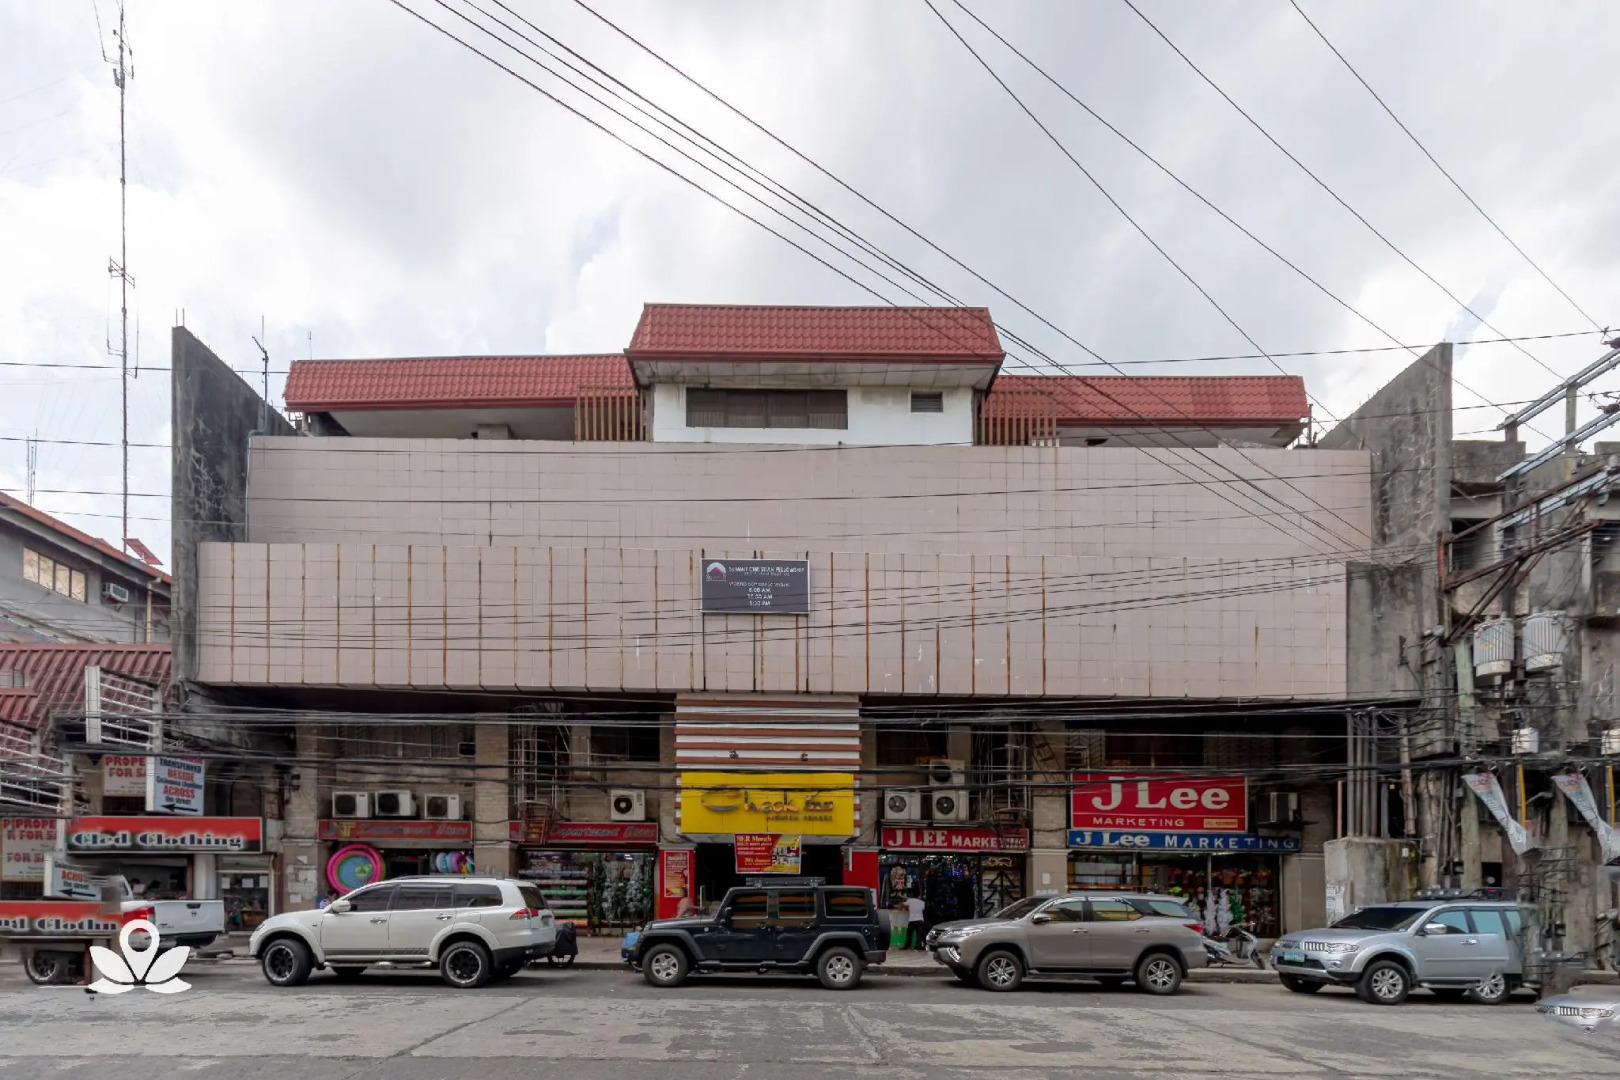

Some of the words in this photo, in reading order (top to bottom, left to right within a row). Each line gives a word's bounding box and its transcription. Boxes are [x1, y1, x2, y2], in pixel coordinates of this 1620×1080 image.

[109, 768, 132, 777] FOR
[163, 785, 195, 799] ACROSS
[1092, 776, 1122, 810] J
[1135, 776, 1230, 810] Lee
[1092, 816, 1184, 828] MARKETING
[138, 832, 243, 848] Clothing
[888, 830, 904, 846] J
[909, 830, 948, 846] LEE
[1076, 832, 1092, 846] J
[1102, 832, 1150, 847] Lee
[1164, 835, 1295, 849] MARKETING
